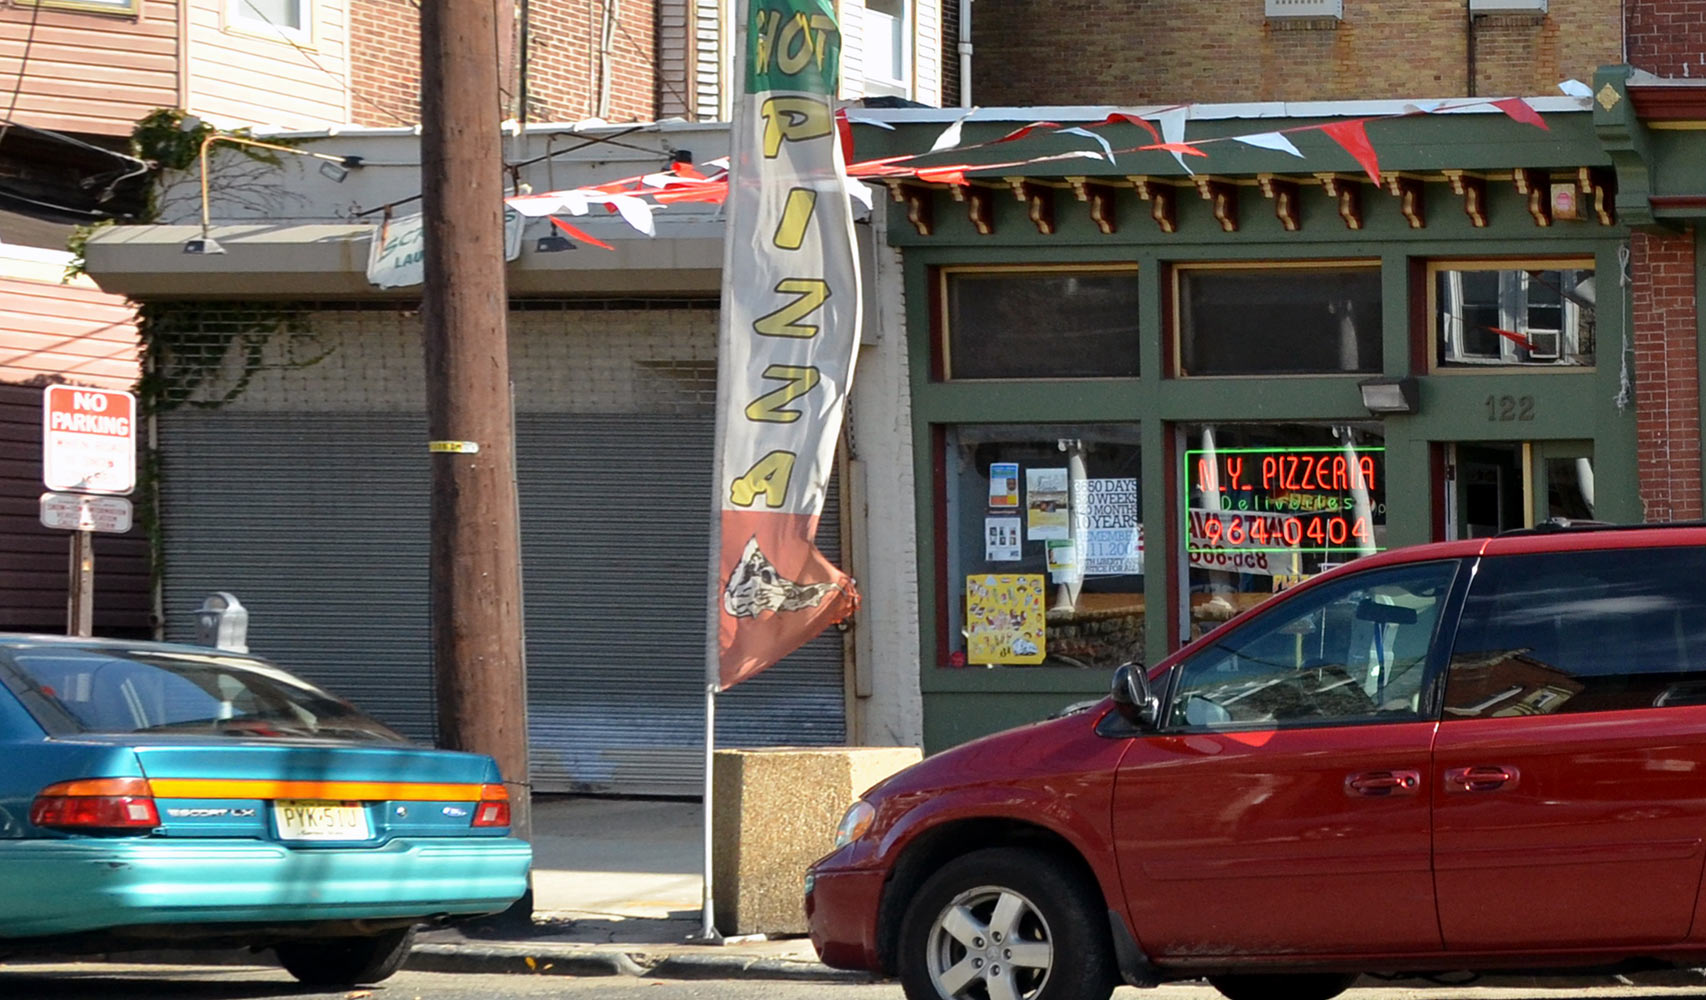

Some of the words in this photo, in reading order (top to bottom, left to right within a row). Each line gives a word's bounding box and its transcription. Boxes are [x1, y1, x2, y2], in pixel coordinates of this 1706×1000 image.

[756, 8, 836, 76] HOT
[730, 95, 833, 508] PIZZA
[73, 392, 108, 412] NO
[1485, 395, 1535, 421] 122
[51, 411, 129, 436] PARKING
[1262, 455, 1375, 490] PIZZERIA
[1105, 480, 1137, 492] DAYS
[1094, 505, 1137, 515] MONTHS
[1096, 493, 1137, 505] WEEKS
[1221, 495, 1354, 511] Deliveries
[1092, 515, 1138, 528] YEARS
[1204, 517, 1371, 545] 964-0404
